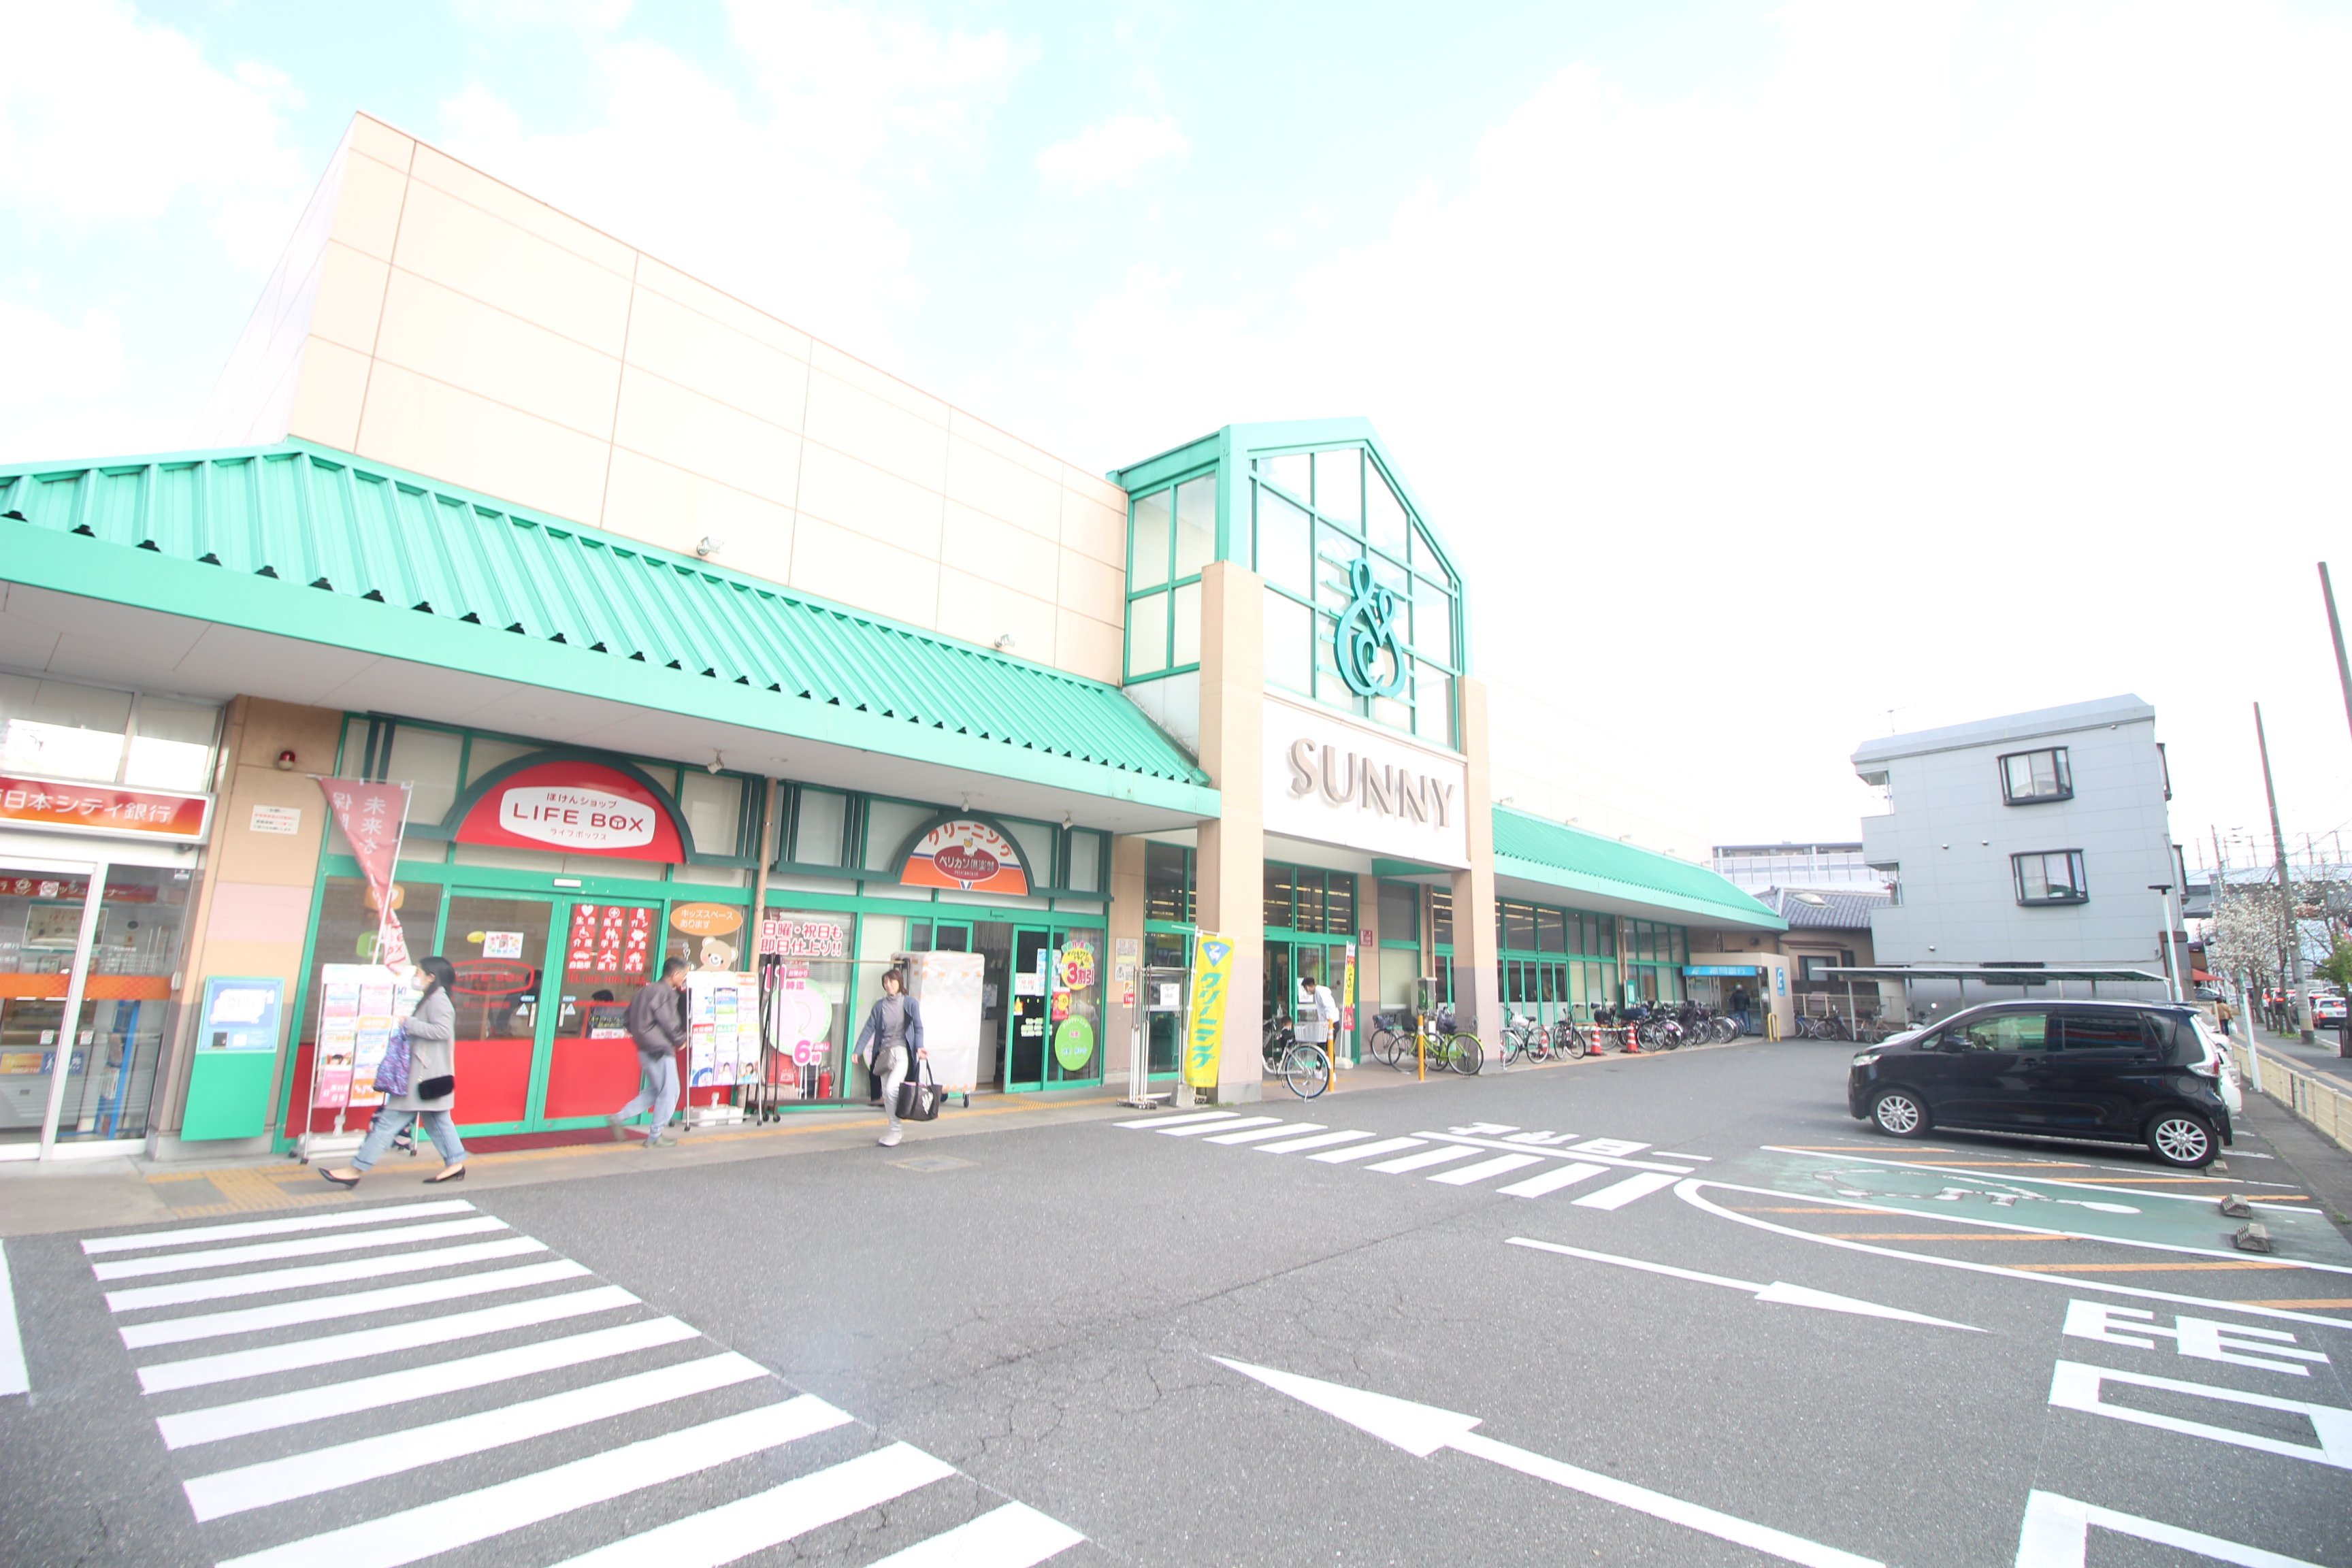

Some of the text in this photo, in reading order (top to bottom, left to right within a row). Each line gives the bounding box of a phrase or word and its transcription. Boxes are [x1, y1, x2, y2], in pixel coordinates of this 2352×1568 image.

[1290, 737, 1455, 828] SUNNY
[546, 791, 617, 809] ほけんショップ
[513, 802, 644, 833] LIFE BOX
[550, 827, 608, 841] ライフボックス
[928, 821, 1013, 858] クリーニング
[575, 915, 595, 926] 生命
[681, 909, 733, 921] キッズスペース
[680, 919, 710, 930] あります
[763, 920, 843, 939] 日曜・祝日も
[760, 938, 842, 956] 即日仕上り!!
[568, 960, 591, 970] 自動車
[597, 961, 617, 971] 旅行
[1191, 972, 1223, 1070] クリーニング
[794, 1039, 811, 1064] 6
